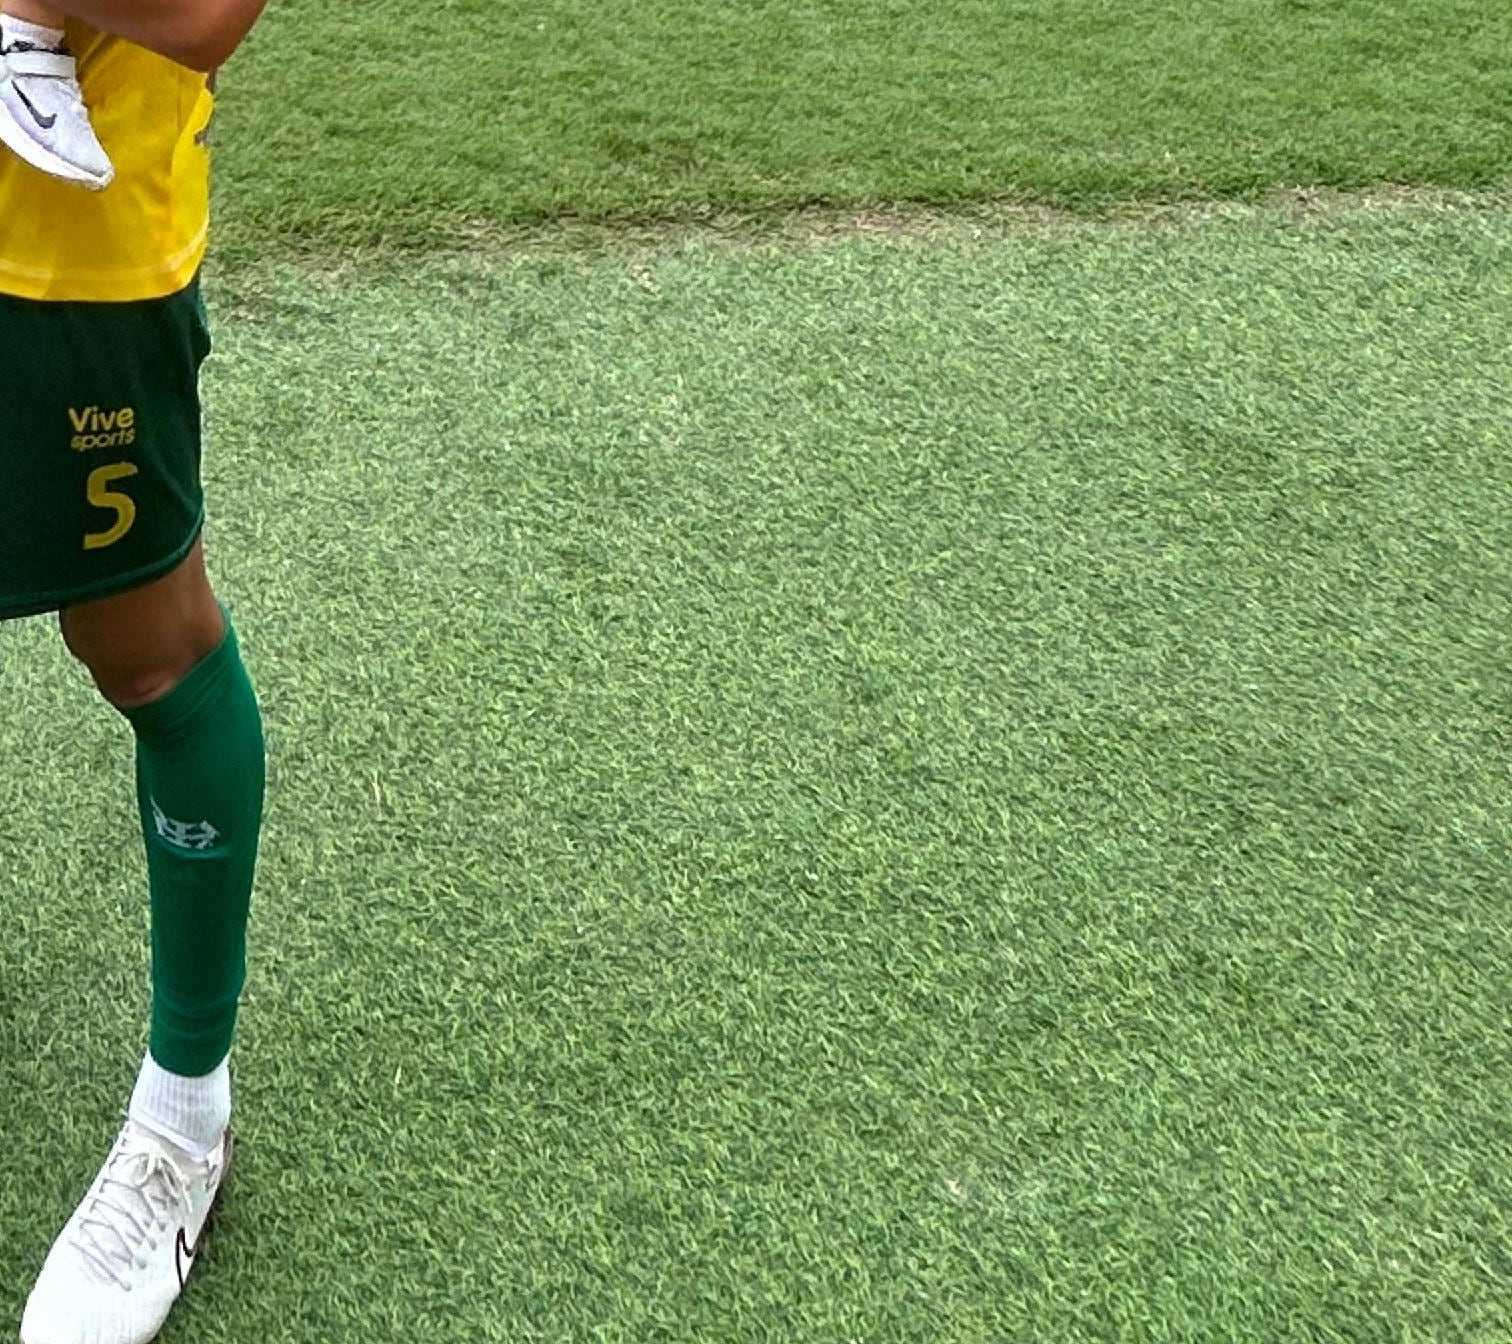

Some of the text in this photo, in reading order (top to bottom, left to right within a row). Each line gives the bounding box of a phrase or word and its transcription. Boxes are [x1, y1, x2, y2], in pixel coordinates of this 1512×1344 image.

[68, 405, 134, 432] Vive
[70, 428, 135, 452] sports
[83, 461, 139, 550] 5
